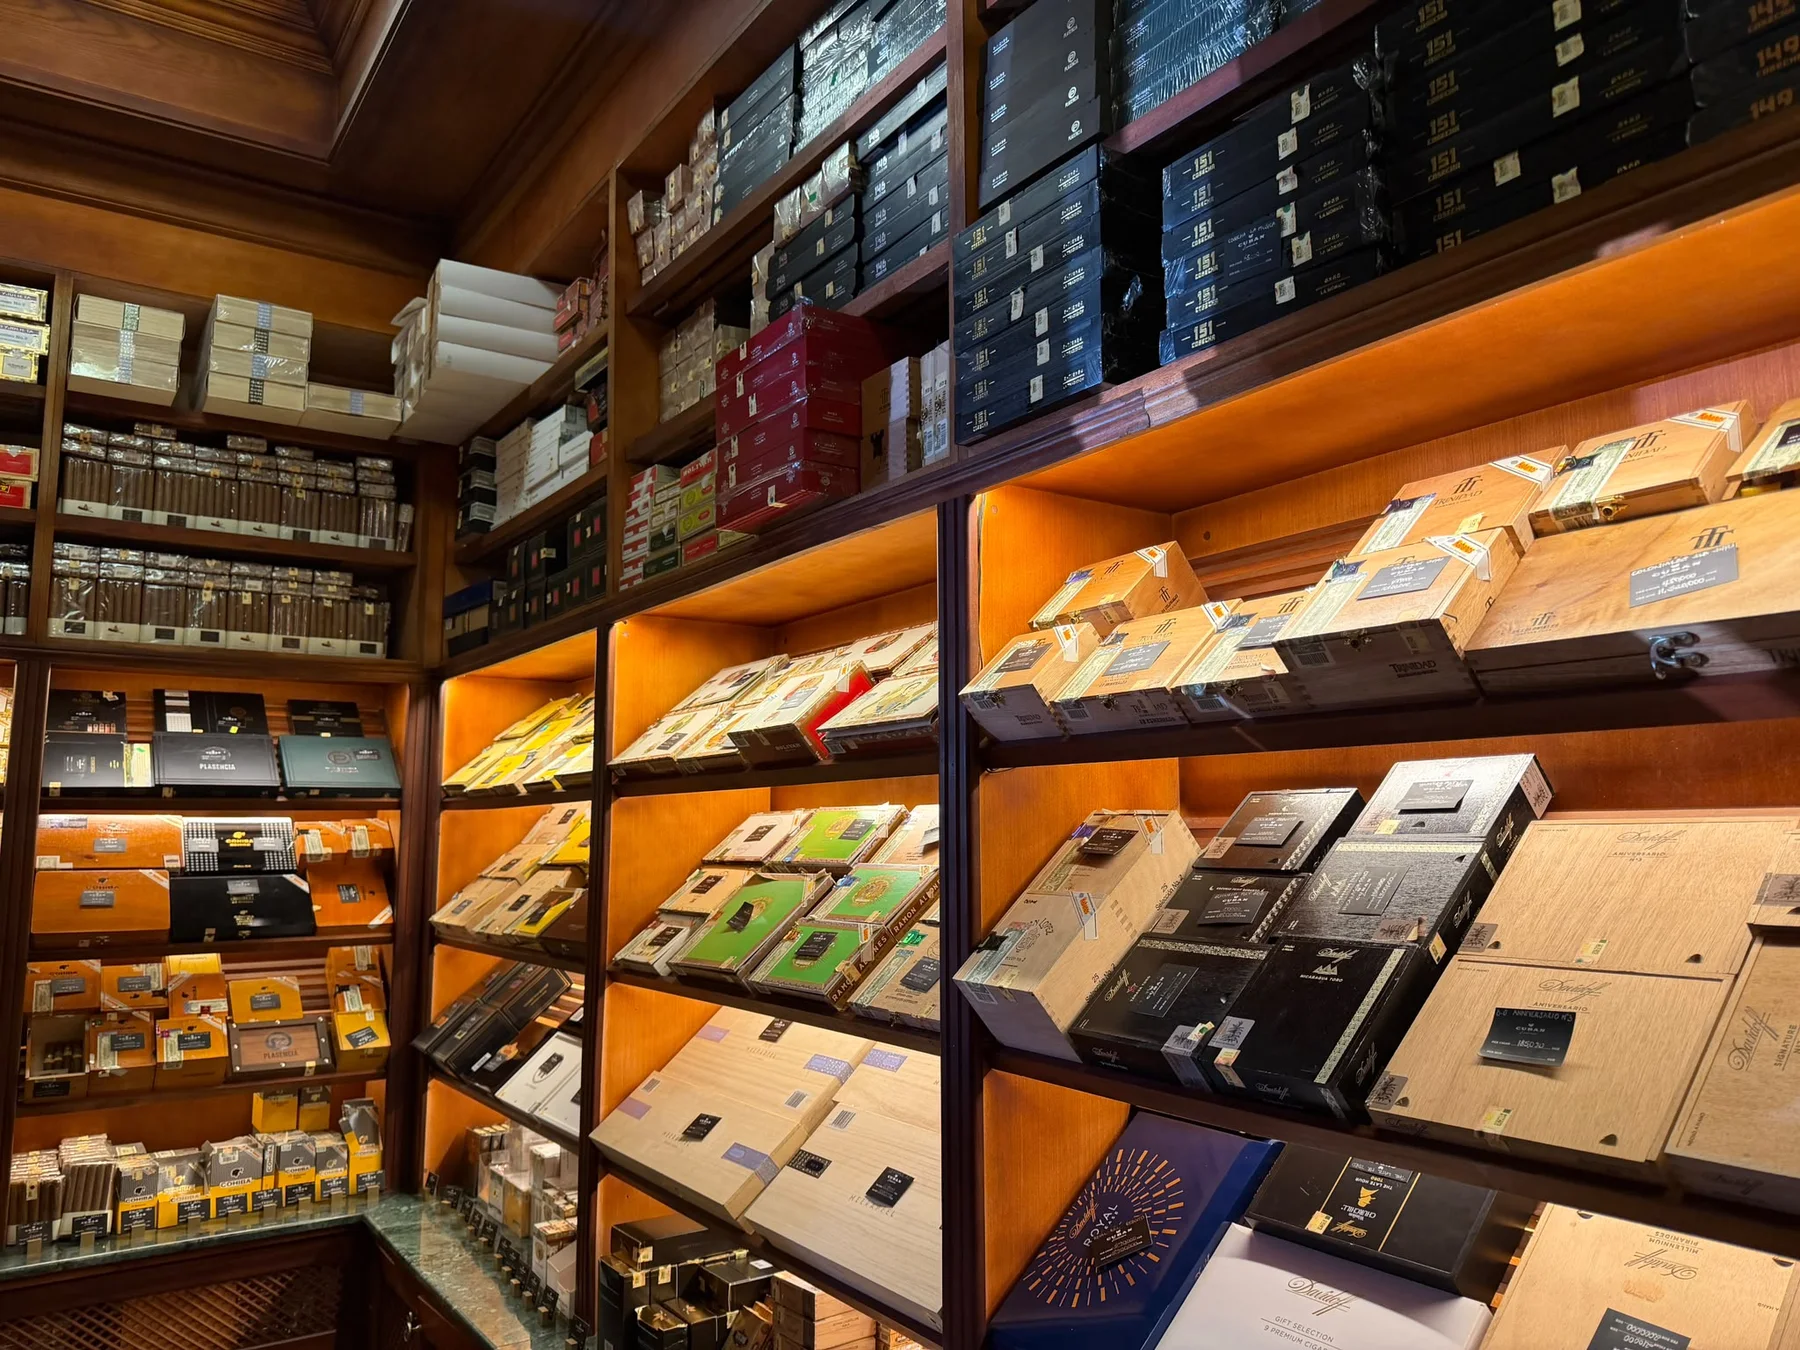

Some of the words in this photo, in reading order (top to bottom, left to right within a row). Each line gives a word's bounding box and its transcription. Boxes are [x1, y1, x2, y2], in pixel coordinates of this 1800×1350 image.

[1426, 29, 1453, 57] 151
[1757, 35, 1800, 68] 149
[1429, 70, 1455, 98] 151
[1750, 87, 1794, 120] 149
[1430, 110, 1456, 136] 151
[1194, 150, 1213, 173] 151
[1430, 147, 1456, 174] 151
[1193, 183, 1212, 205] 151
[1436, 188, 1462, 212] 151
[1193, 218, 1212, 240] 151
[1436, 229, 1462, 253] 151
[1197, 250, 1216, 272] 151
[1197, 284, 1216, 305] 151
[1193, 320, 1213, 341] 151
[1434, 490, 1483, 507] TRINIDAD
[1389, 660, 1437, 673] TRINIDAD
[199, 763, 236, 771] PLASENCIA
[1616, 830, 1688, 851] Davidoff
[892, 907, 917, 934] RAMON
[1537, 978, 1613, 1003] Davidoff
[1532, 1001, 1589, 1012] ANIVERSARIO
[1728, 1005, 1780, 1072] Davidoff
[1773, 1024, 1797, 1067] SIGNATURE
[263, 1050, 299, 1060] PLASENCIA
[285, 1165, 311, 1175] COHIBA
[220, 1178, 253, 1188] COHIBA
[125, 1195, 154, 1203] COHIBA
[1083, 1204, 1119, 1248] ROYAL
[1648, 1238, 1699, 1255] MILLENNIUM
[1655, 1230, 1699, 1247] PIRAMIDES
[1624, 1248, 1699, 1281] Davidoff
[1285, 1276, 1365, 1317] Davidoff
[1270, 1327, 1303, 1345] PREMIUM
[1275, 1315, 1292, 1328] GIFT
[1292, 1322, 1335, 1344] SELECTION
